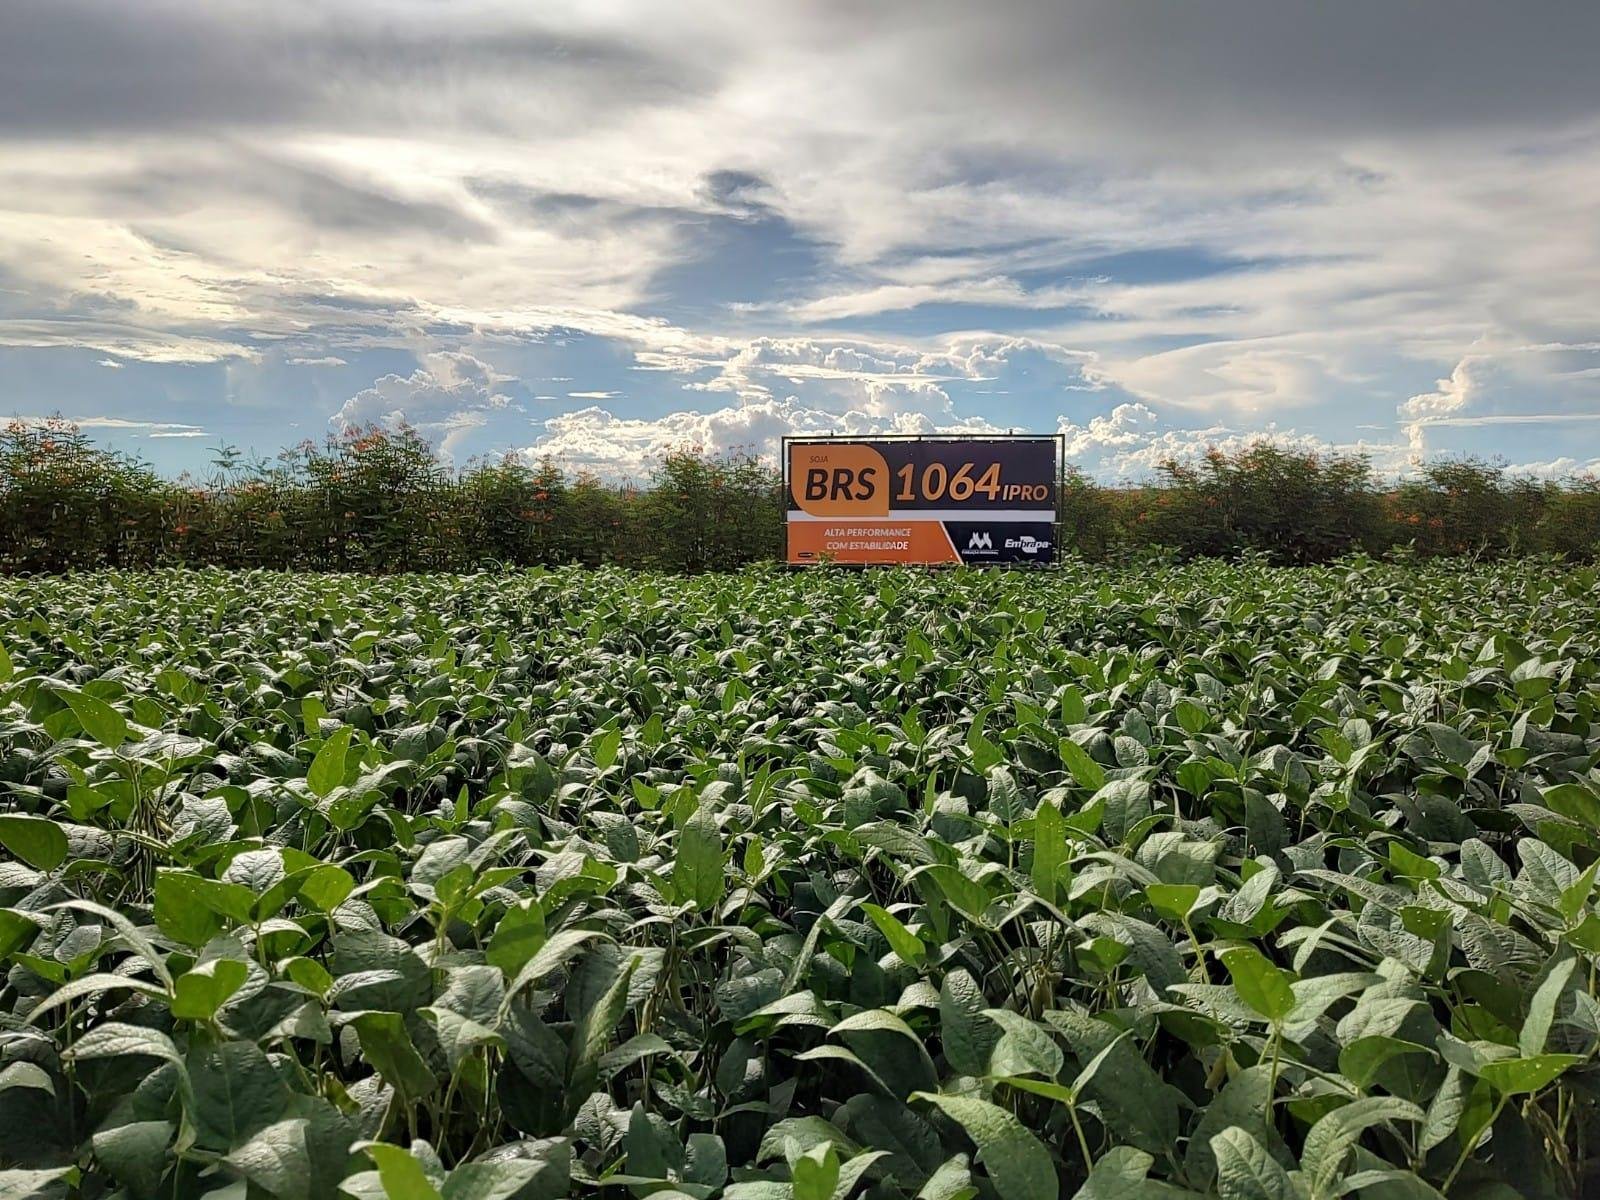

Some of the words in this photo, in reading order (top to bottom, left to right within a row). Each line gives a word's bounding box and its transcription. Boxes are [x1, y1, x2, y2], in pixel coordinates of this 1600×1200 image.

[809, 455, 829, 464] SOJA
[805, 468, 876, 501] BRS
[896, 462, 1001, 501] 1064
[1003, 484, 1049, 501] IPRO
[824, 528, 845, 537] ALTA
[847, 528, 912, 537] PERFORMANCE
[826, 541, 848, 550] COM
[849, 541, 909, 550] ESTABILIDADE
[1005, 537, 1051, 553] Embrapa
